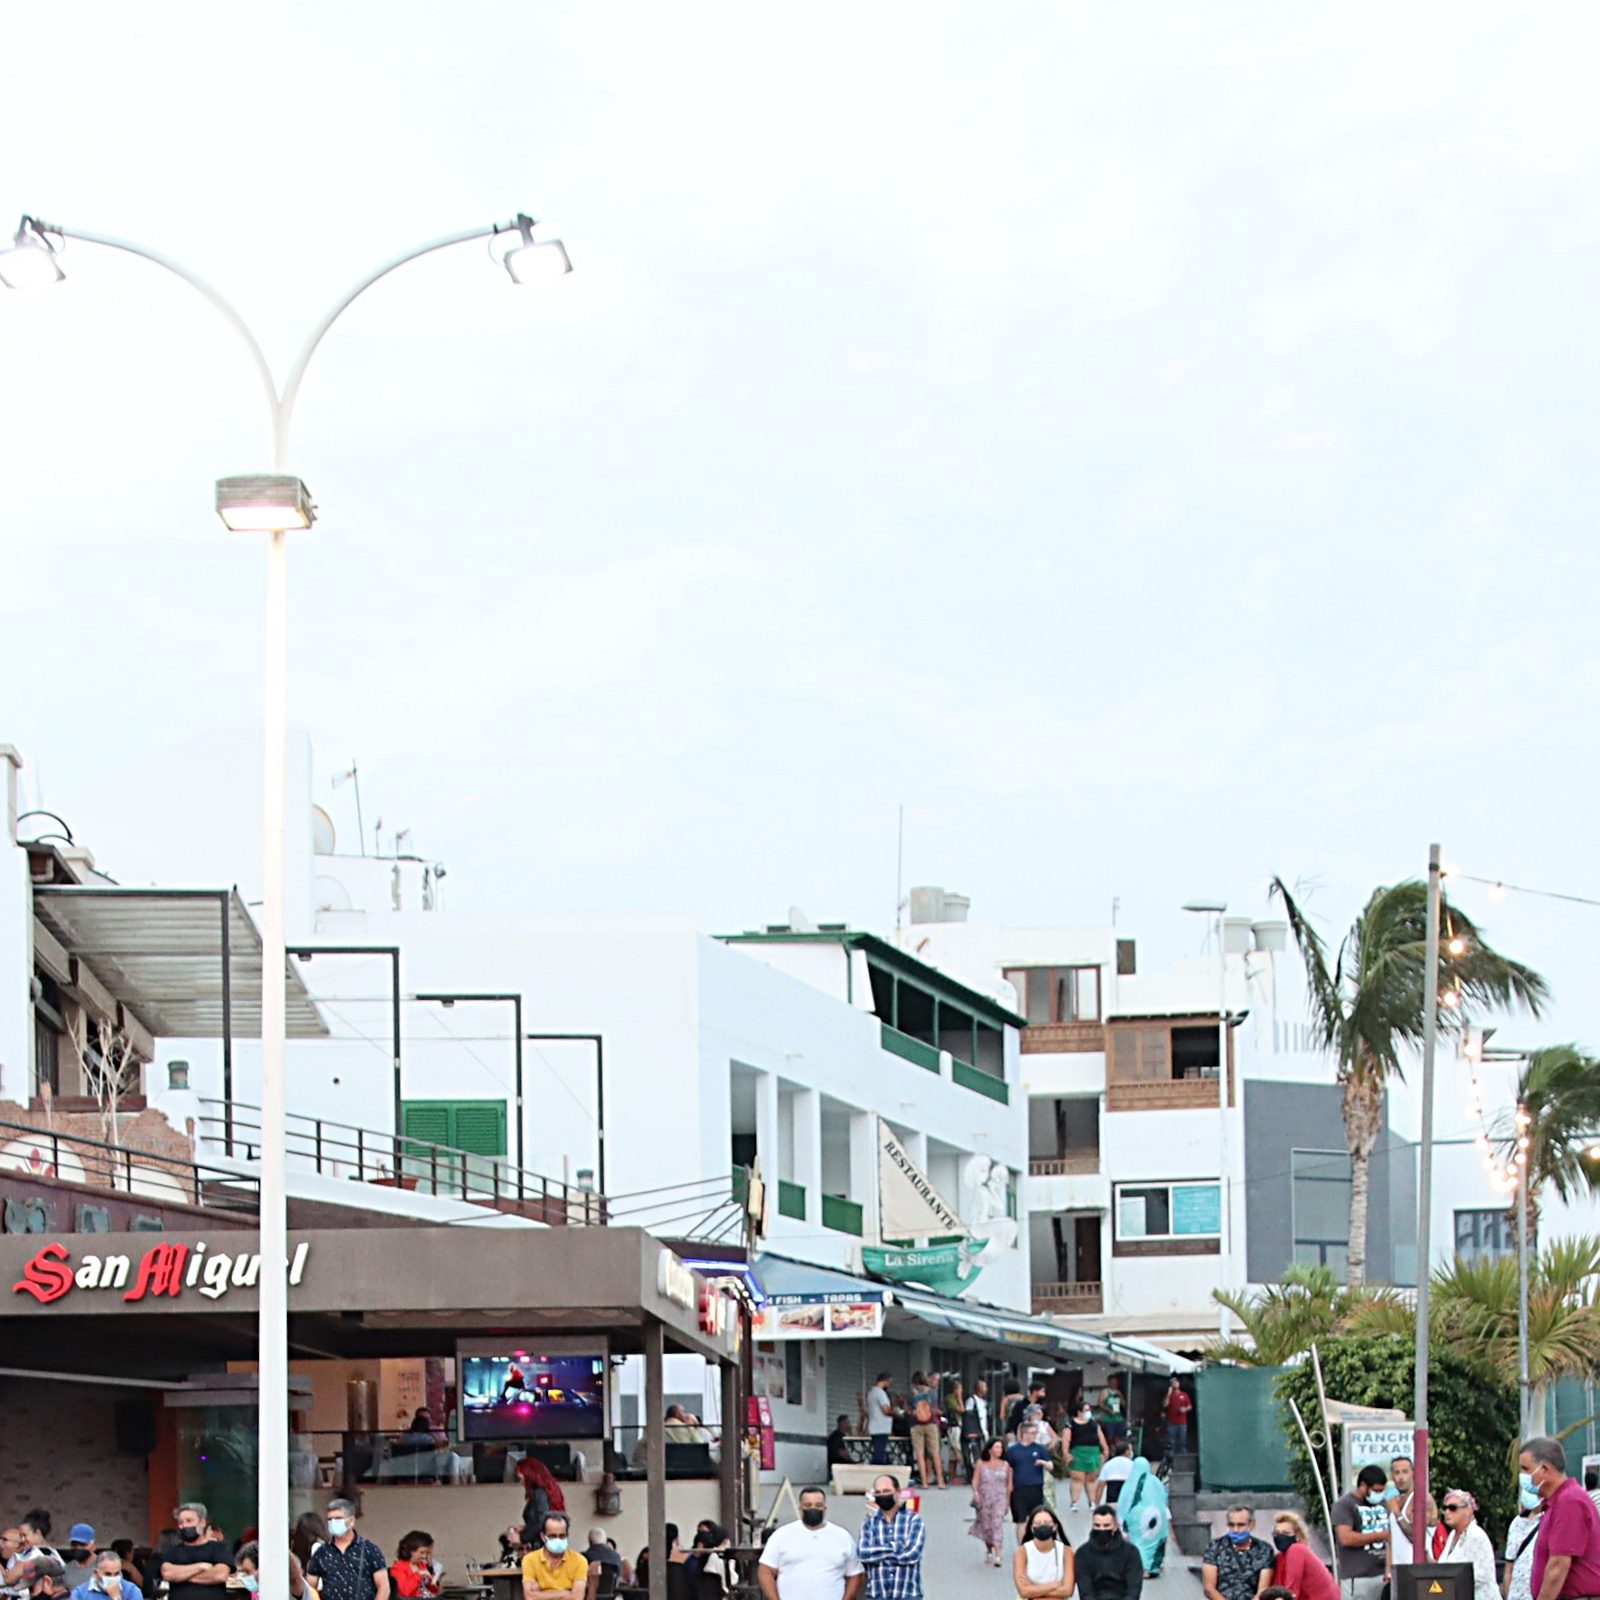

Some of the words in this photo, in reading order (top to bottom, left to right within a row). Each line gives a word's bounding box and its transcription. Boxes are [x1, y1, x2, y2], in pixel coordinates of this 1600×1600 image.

[883, 1140, 957, 1231] RESTAURANTE
[13, 1241, 130, 1303] San
[124, 1241, 309, 1301] Migul
[884, 1253, 903, 1267] La
[907, 1252, 954, 1266] Sirena
[1360, 1444, 1412, 1454] TEXAS
